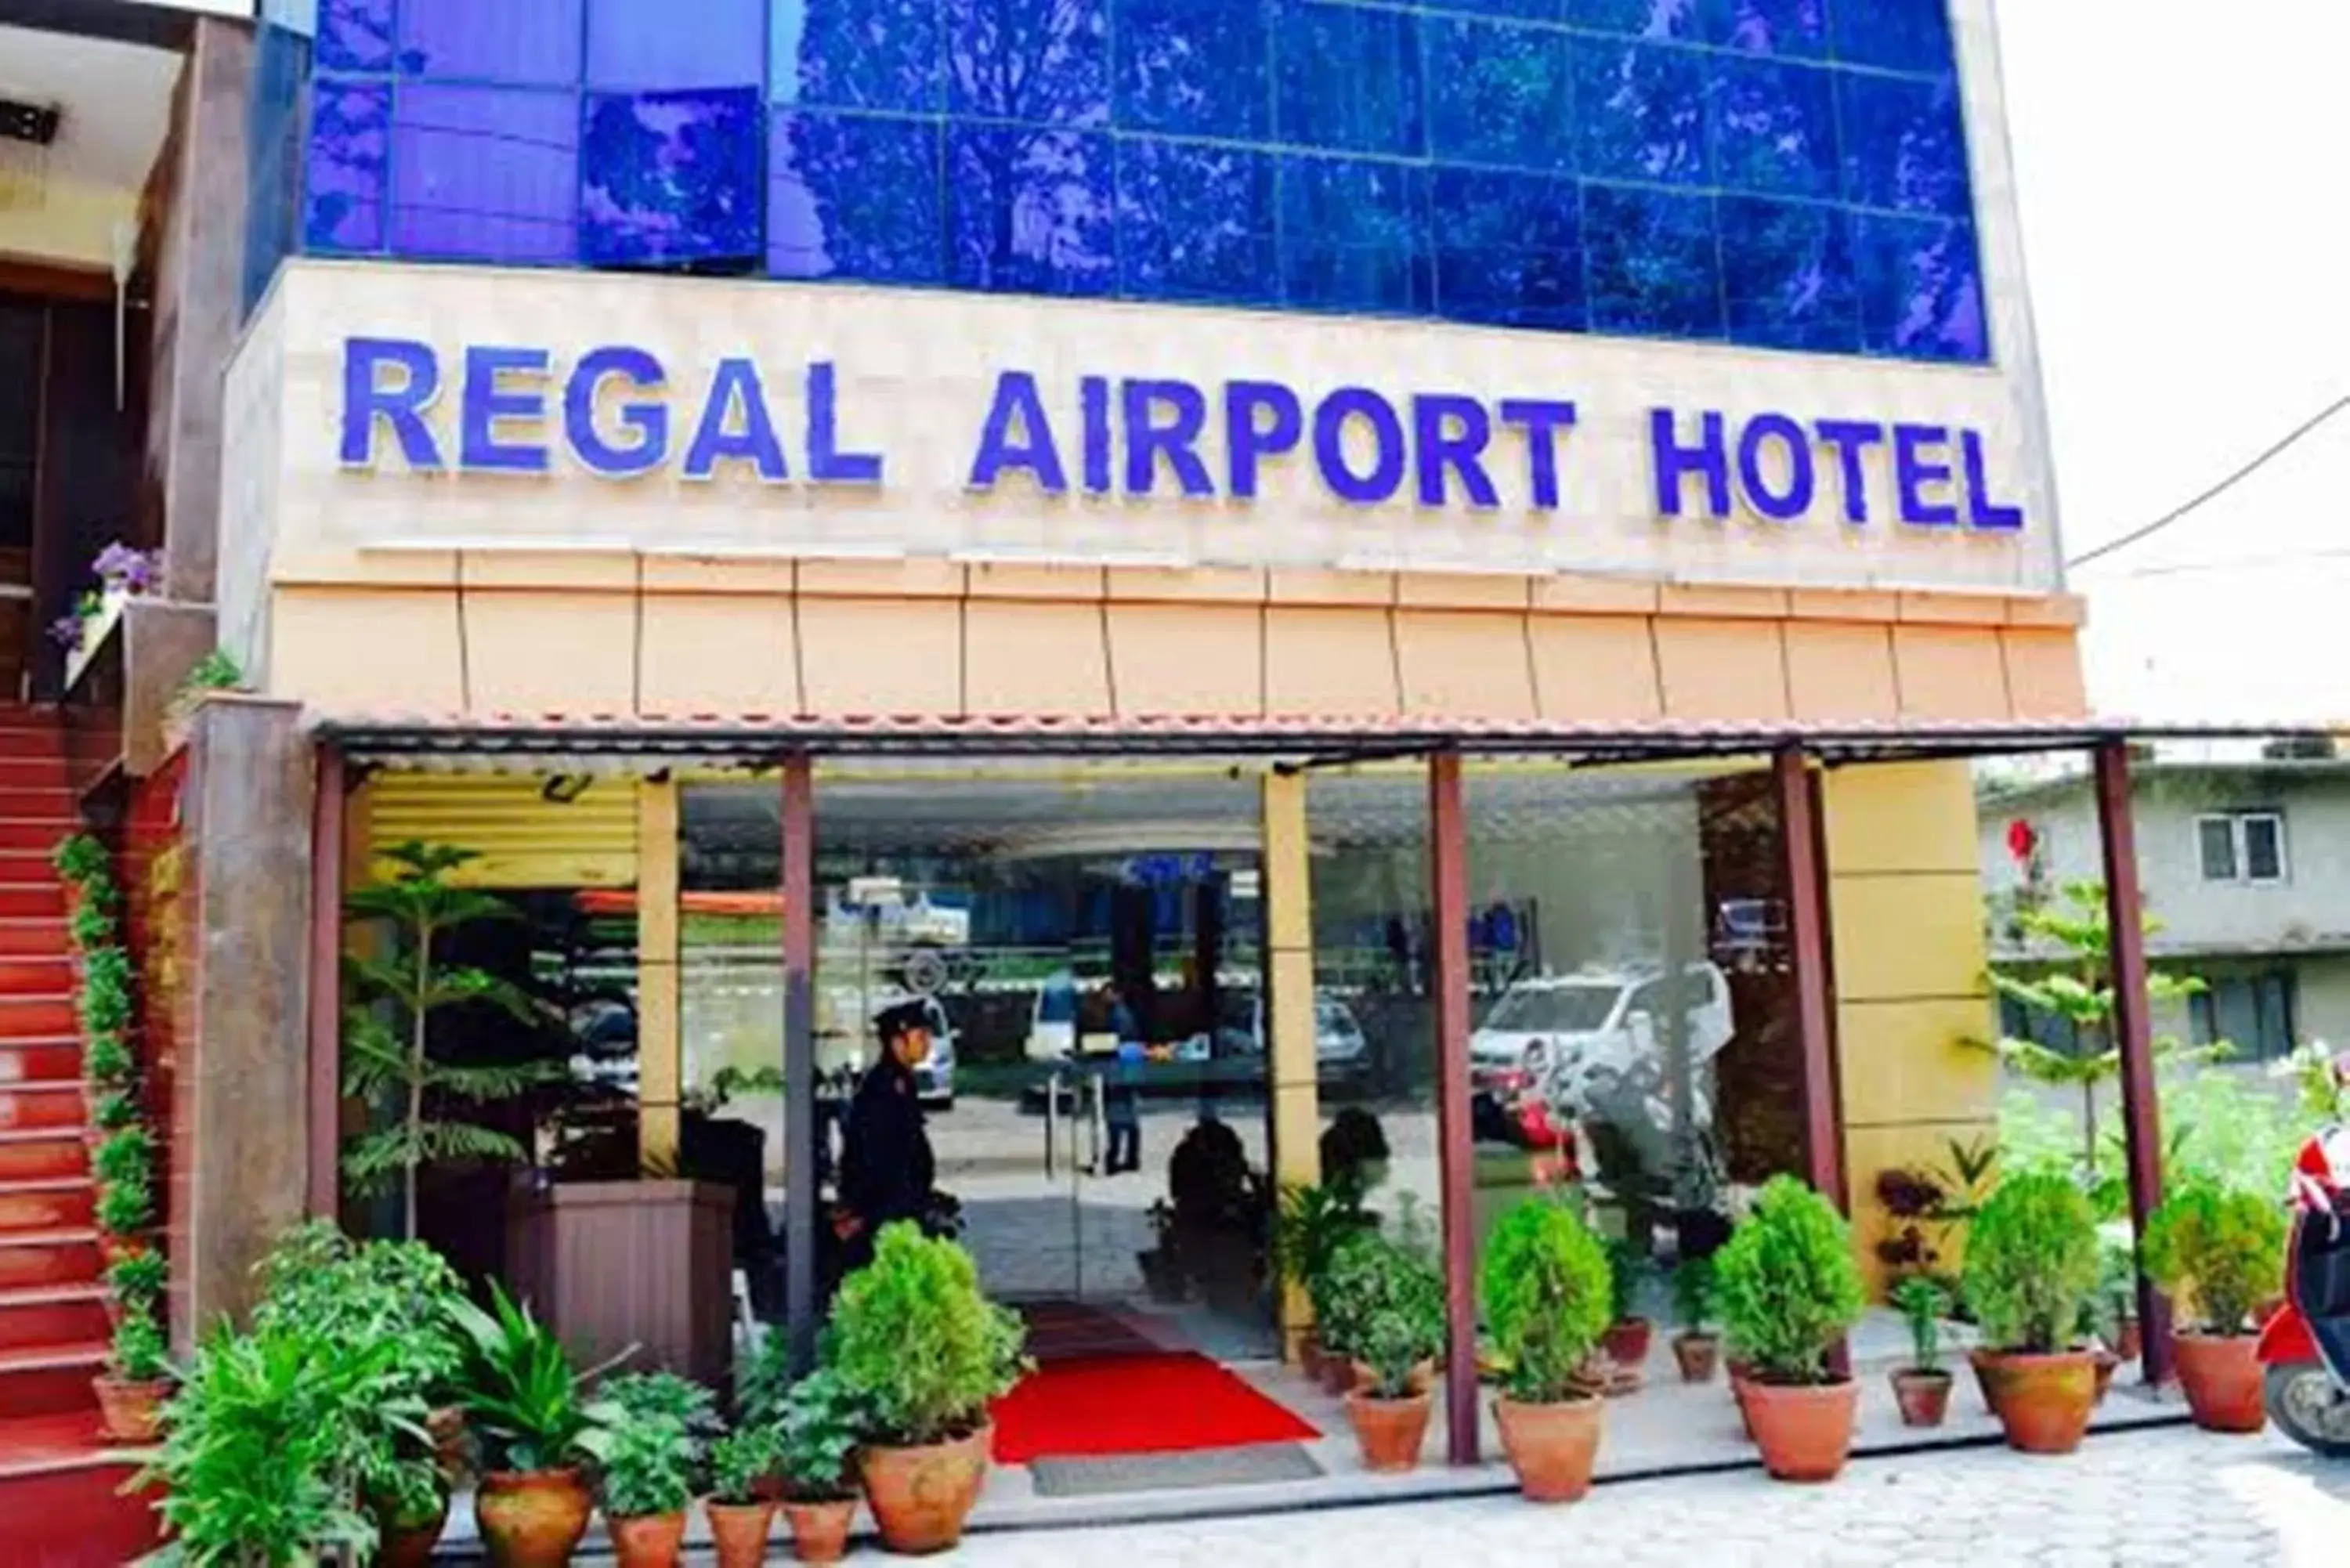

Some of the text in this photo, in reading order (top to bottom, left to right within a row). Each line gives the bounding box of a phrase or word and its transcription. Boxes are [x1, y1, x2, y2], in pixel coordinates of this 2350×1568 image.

[340, 337, 2024, 530] REGAL AIRPORT HOTEL
